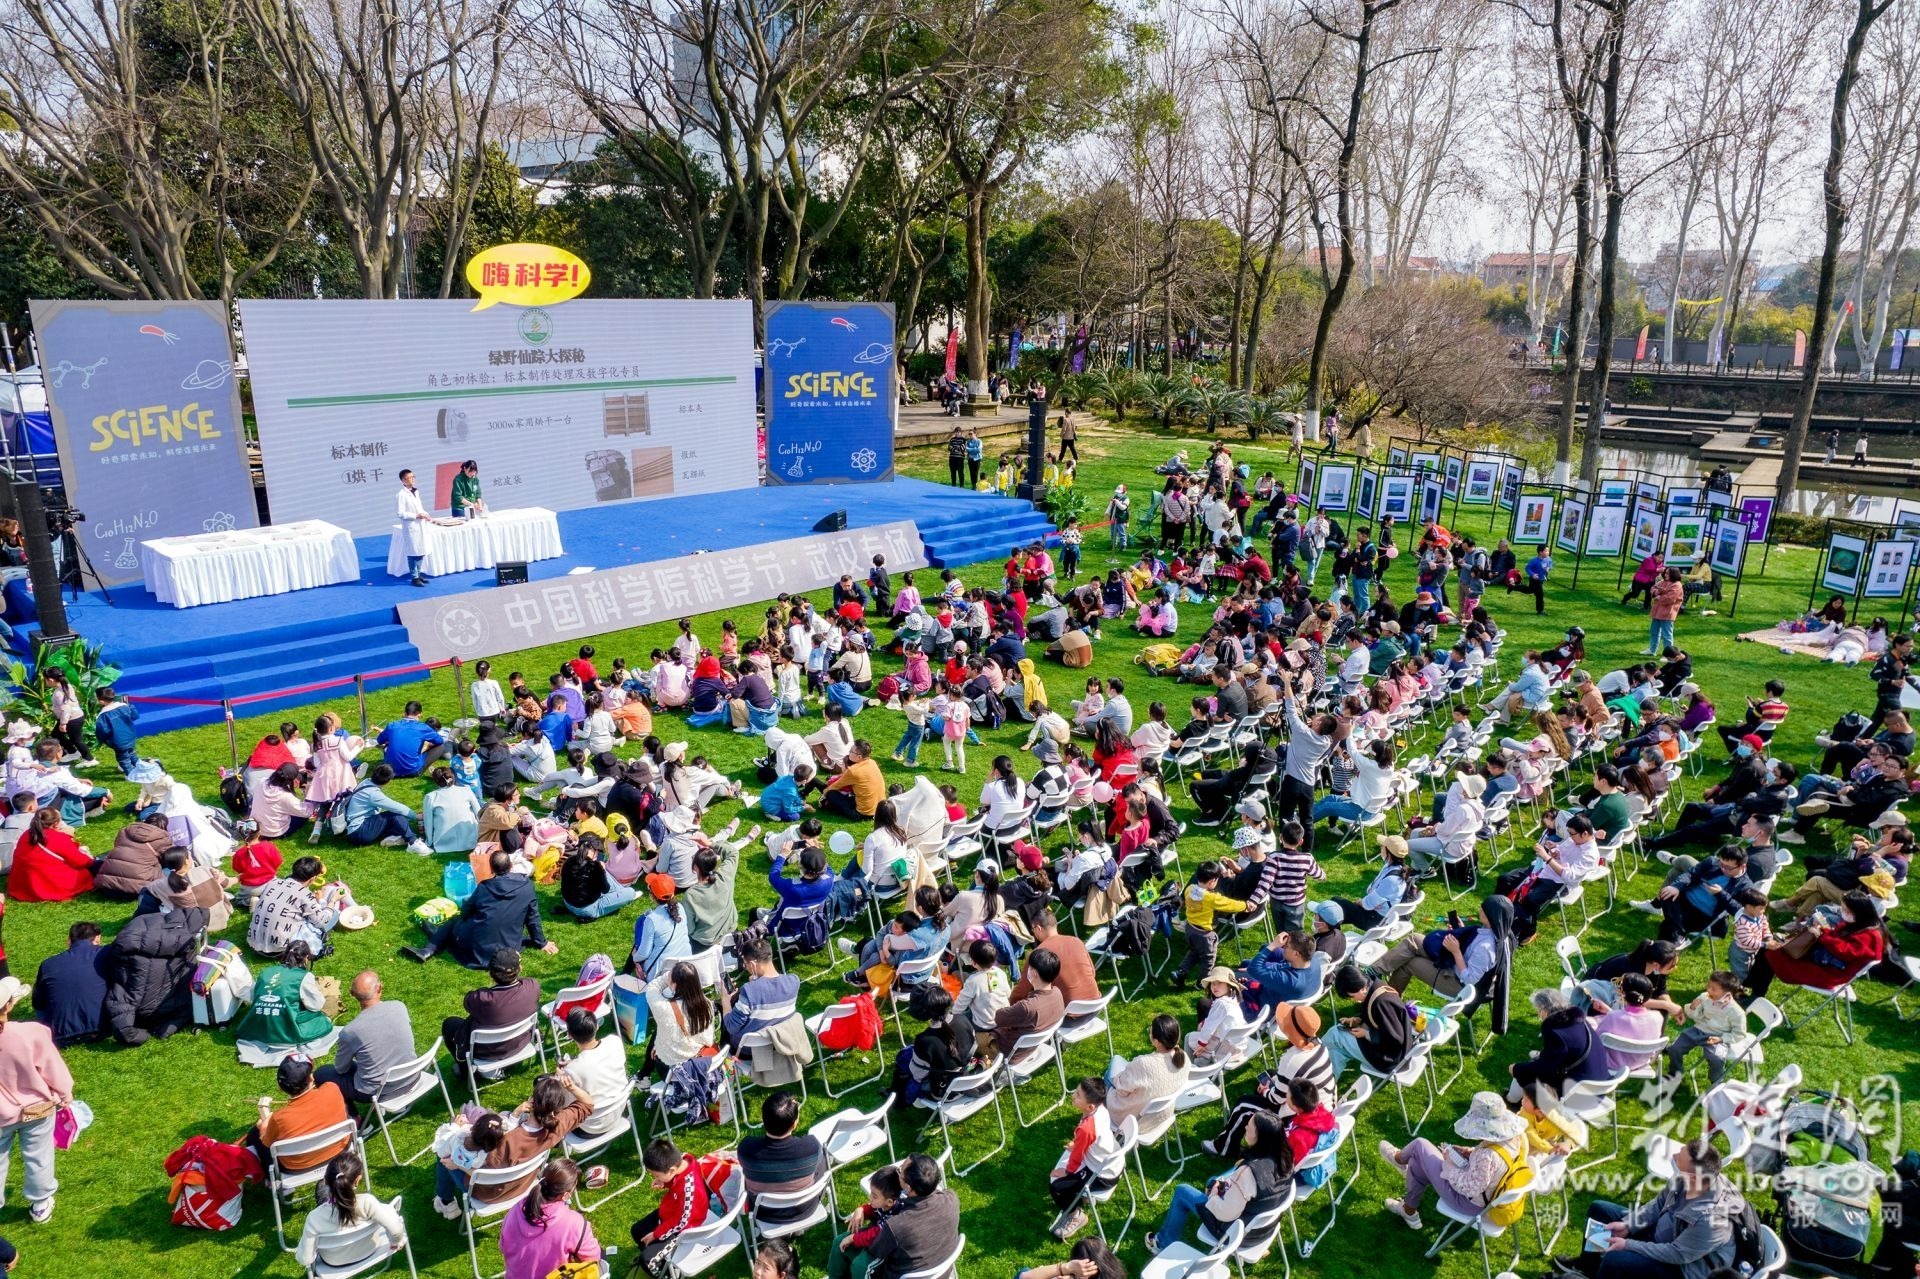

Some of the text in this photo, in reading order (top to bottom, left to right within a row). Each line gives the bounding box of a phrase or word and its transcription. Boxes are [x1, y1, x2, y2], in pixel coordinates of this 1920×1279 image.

[482, 262, 579, 287] 嗨科学！
[488, 348, 586, 366] 绿野仙踪大探秘
[427, 365, 640, 387] 角色初体验：标本制作处理及数字化专员
[331, 442, 389, 460] 标本制作
